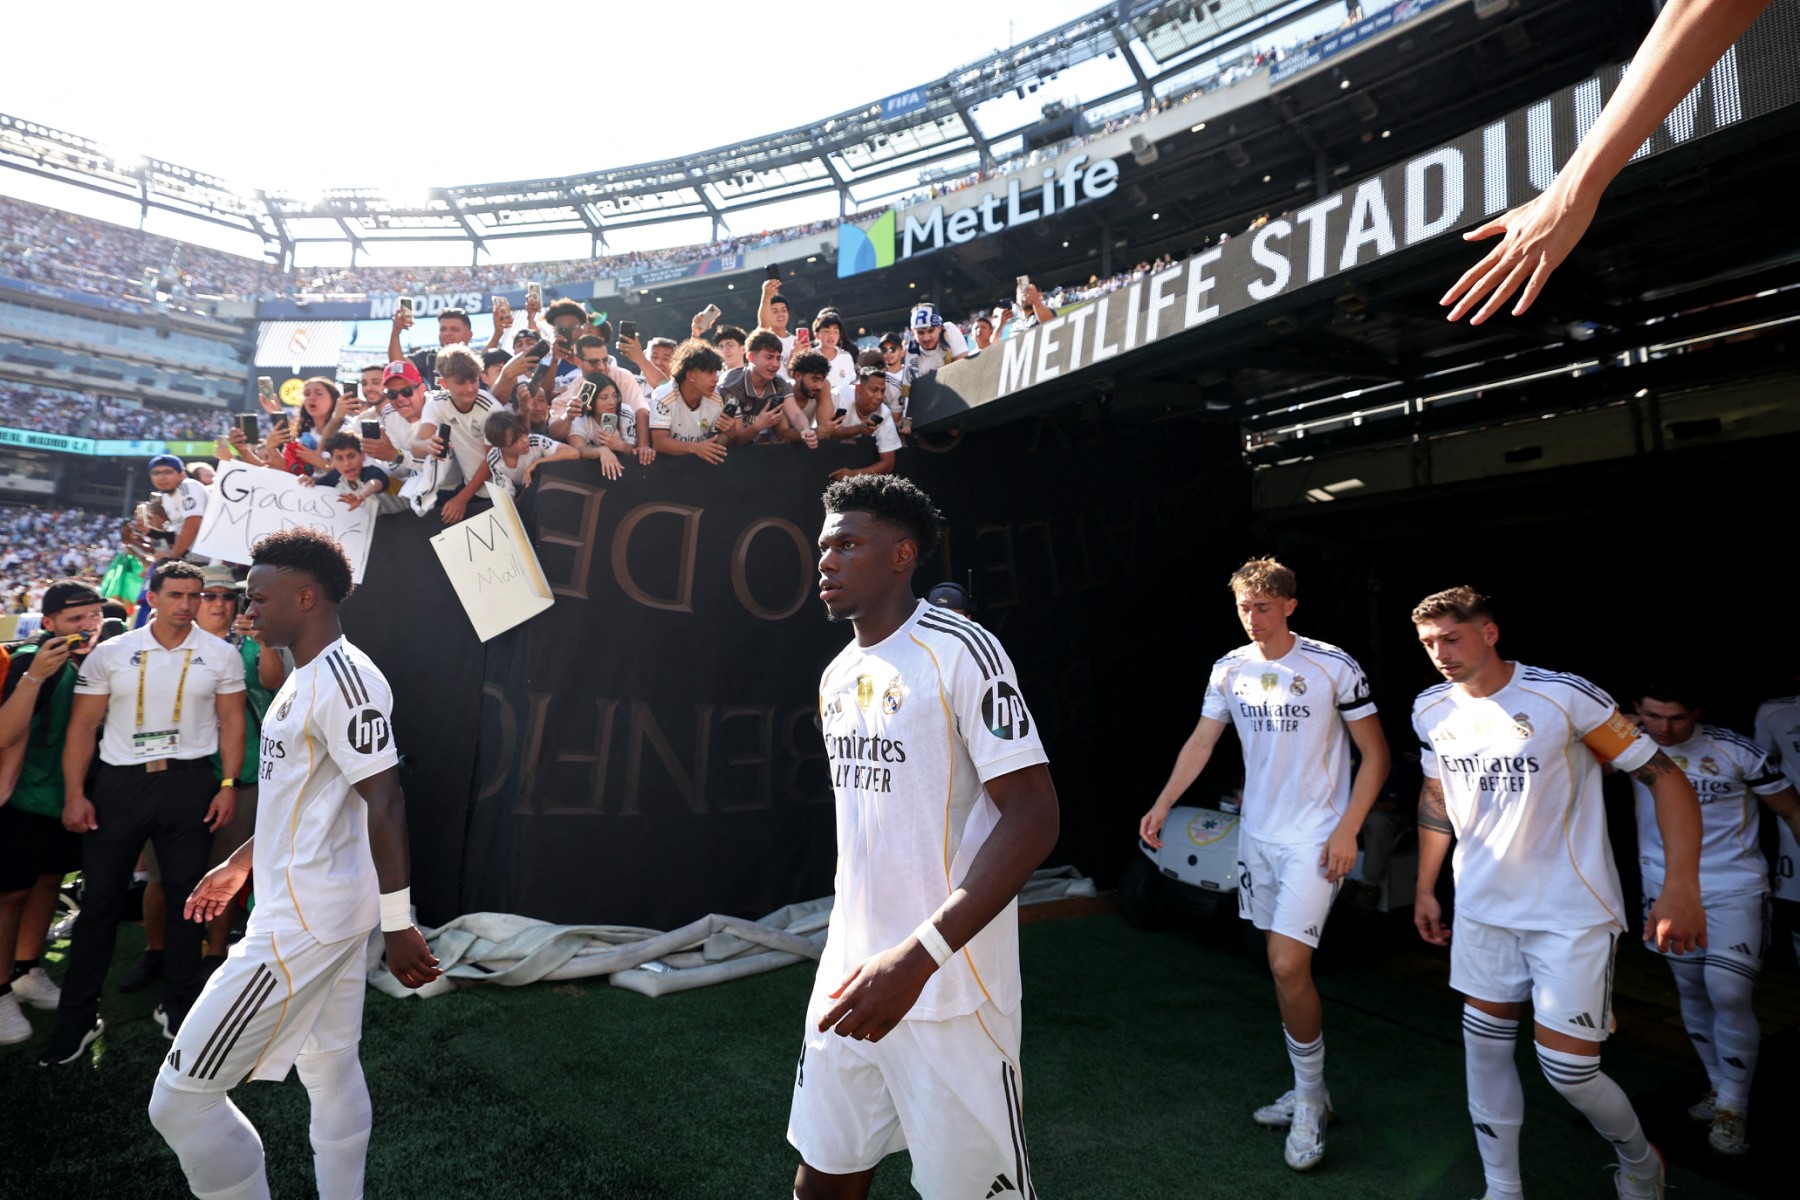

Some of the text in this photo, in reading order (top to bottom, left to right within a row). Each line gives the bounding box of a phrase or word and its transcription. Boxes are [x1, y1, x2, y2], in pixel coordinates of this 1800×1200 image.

[887, 91, 920, 111] FIFA
[902, 152, 1120, 259] MetLife
[369, 291, 483, 319] MODY'S
[997, 246, 1223, 398] METLIFE
[220, 468, 336, 519] Gracias
[992, 681, 1025, 741] hp
[1240, 700, 1311, 718] Emirates
[356, 708, 385, 754] hp
[825, 729, 906, 763] Emirtes
[1440, 753, 1540, 773] Emirates
